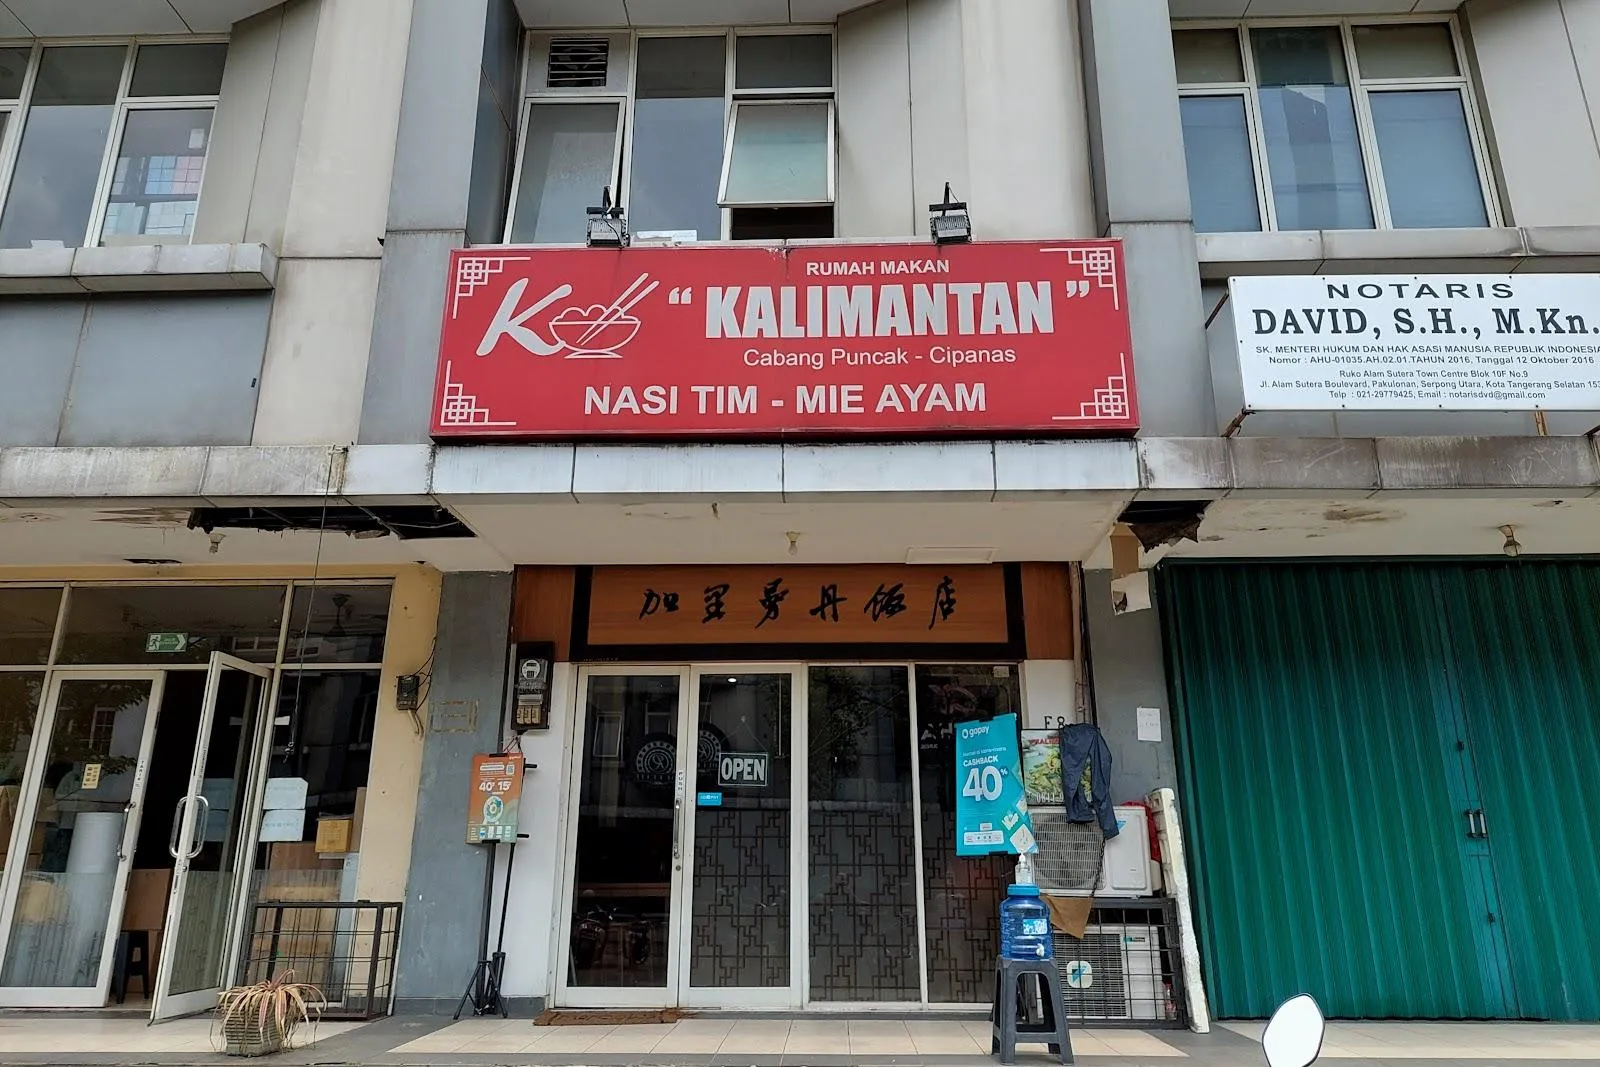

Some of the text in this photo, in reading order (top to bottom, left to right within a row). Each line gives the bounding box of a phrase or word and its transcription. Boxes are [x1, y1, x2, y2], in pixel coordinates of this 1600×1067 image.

[806, 259, 949, 276] RUMAH MAKAN
[1327, 283, 1514, 299] NOTARIS
[1252, 307, 1600, 340] DAVID, S.H., M.Kn.
[1256, 345, 1273, 354] SK.
[1275, 345, 1320, 354] MENTERI
[1323, 345, 1360, 354] HUKUM
[1363, 345, 1384, 354] DAN
[1387, 345, 1409, 354] HAK
[1411, 345, 1442, 354] ASASI
[1445, 345, 1492, 354] MANUSIA
[1494, 345, 1546, 354] REPUBLIK
[743, 348, 824, 370] Cabang
[831, 347, 908, 366] Puncak
[929, 346, 1017, 367] Cipanas
[1269, 356, 1302, 364] Nomor
[1448, 355, 1474, 365] 2016,
[1475, 355, 1514, 366] Tanggal
[1516, 356, 1528, 364] 12
[1530, 356, 1569, 364] Oktober
[1571, 356, 1595, 364] 2016
[1339, 370, 1529, 378] Ruko Alam Sutera Town Centre Blok 10F No.9
[1272, 380, 1293, 388] Alam
[1295, 380, 1323, 388] Sutera
[1324, 380, 1371, 389] Boulevard,
[1372, 380, 1419, 389] Pakulonan,
[1421, 380, 1457, 390] Serpong
[1458, 380, 1484, 389] Utara,
[1485, 380, 1506, 388] Kota
[1506, 380, 1552, 390] Tangerang
[1553, 380, 1586, 388] Selatan
[584, 385, 678, 415] NASI
[691, 385, 758, 415] TIM
[796, 385, 865, 414] MIE
[875, 383, 987, 413] AYAM
[1418, 390, 1442, 398] Email
[963, 754, 999, 767] CASHBACK
[720, 757, 766, 781] OPEN
